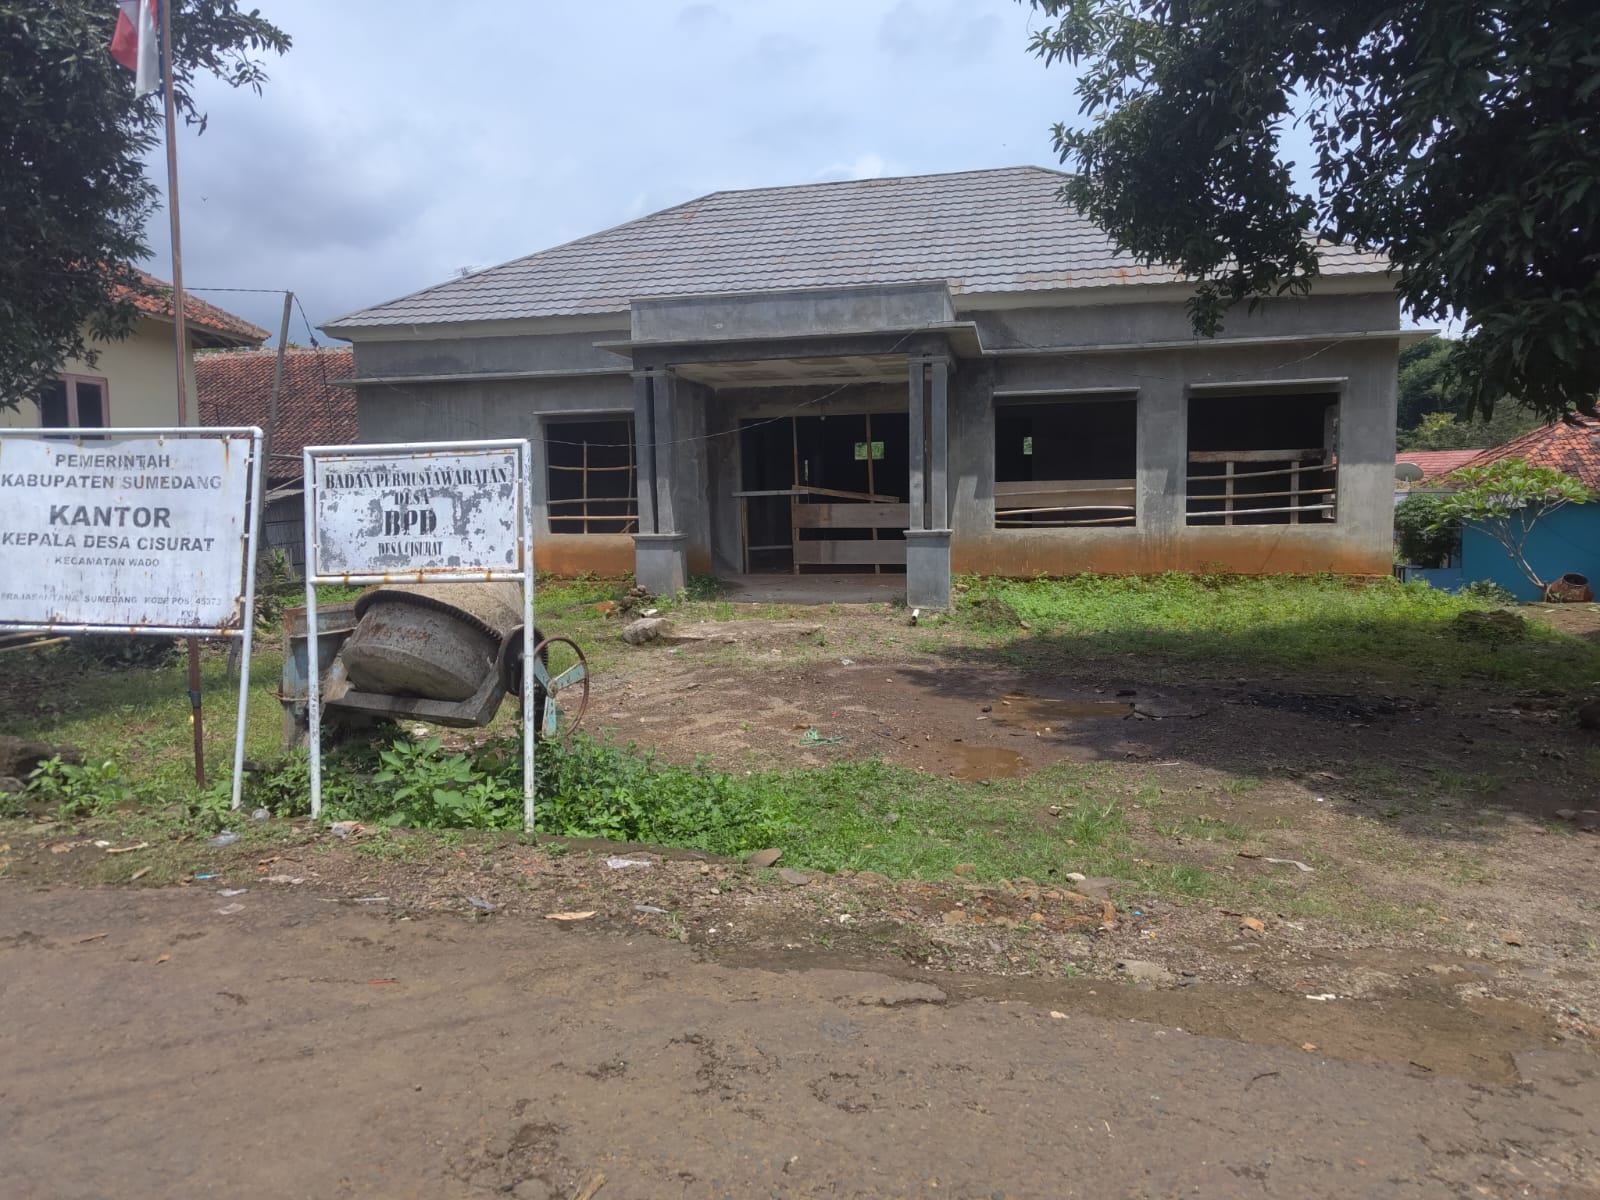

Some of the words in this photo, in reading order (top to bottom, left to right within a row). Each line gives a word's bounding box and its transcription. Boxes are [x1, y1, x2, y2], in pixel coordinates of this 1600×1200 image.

[55, 454, 170, 468] PEMERINTAH
[1, 473, 114, 489] KABUPATEN
[121, 475, 222, 490] SUMEDANG
[326, 473, 373, 489] BADAN
[376, 468, 507, 487] PERMUSYAWARATAN
[394, 492, 429, 505] DESA
[49, 505, 171, 528] KANTOR
[384, 510, 437, 536] BPD
[2, 532, 76, 547] KEPALA
[83, 535, 130, 549] DESA
[137, 536, 214, 551] CISURAT
[378, 542, 402, 555] DESA
[404, 541, 443, 556] CISURAT
[54, 558, 126, 567] KECAMATAN
[128, 559, 159, 567] WADO
[84, 595, 137, 604] SUMEDANG
